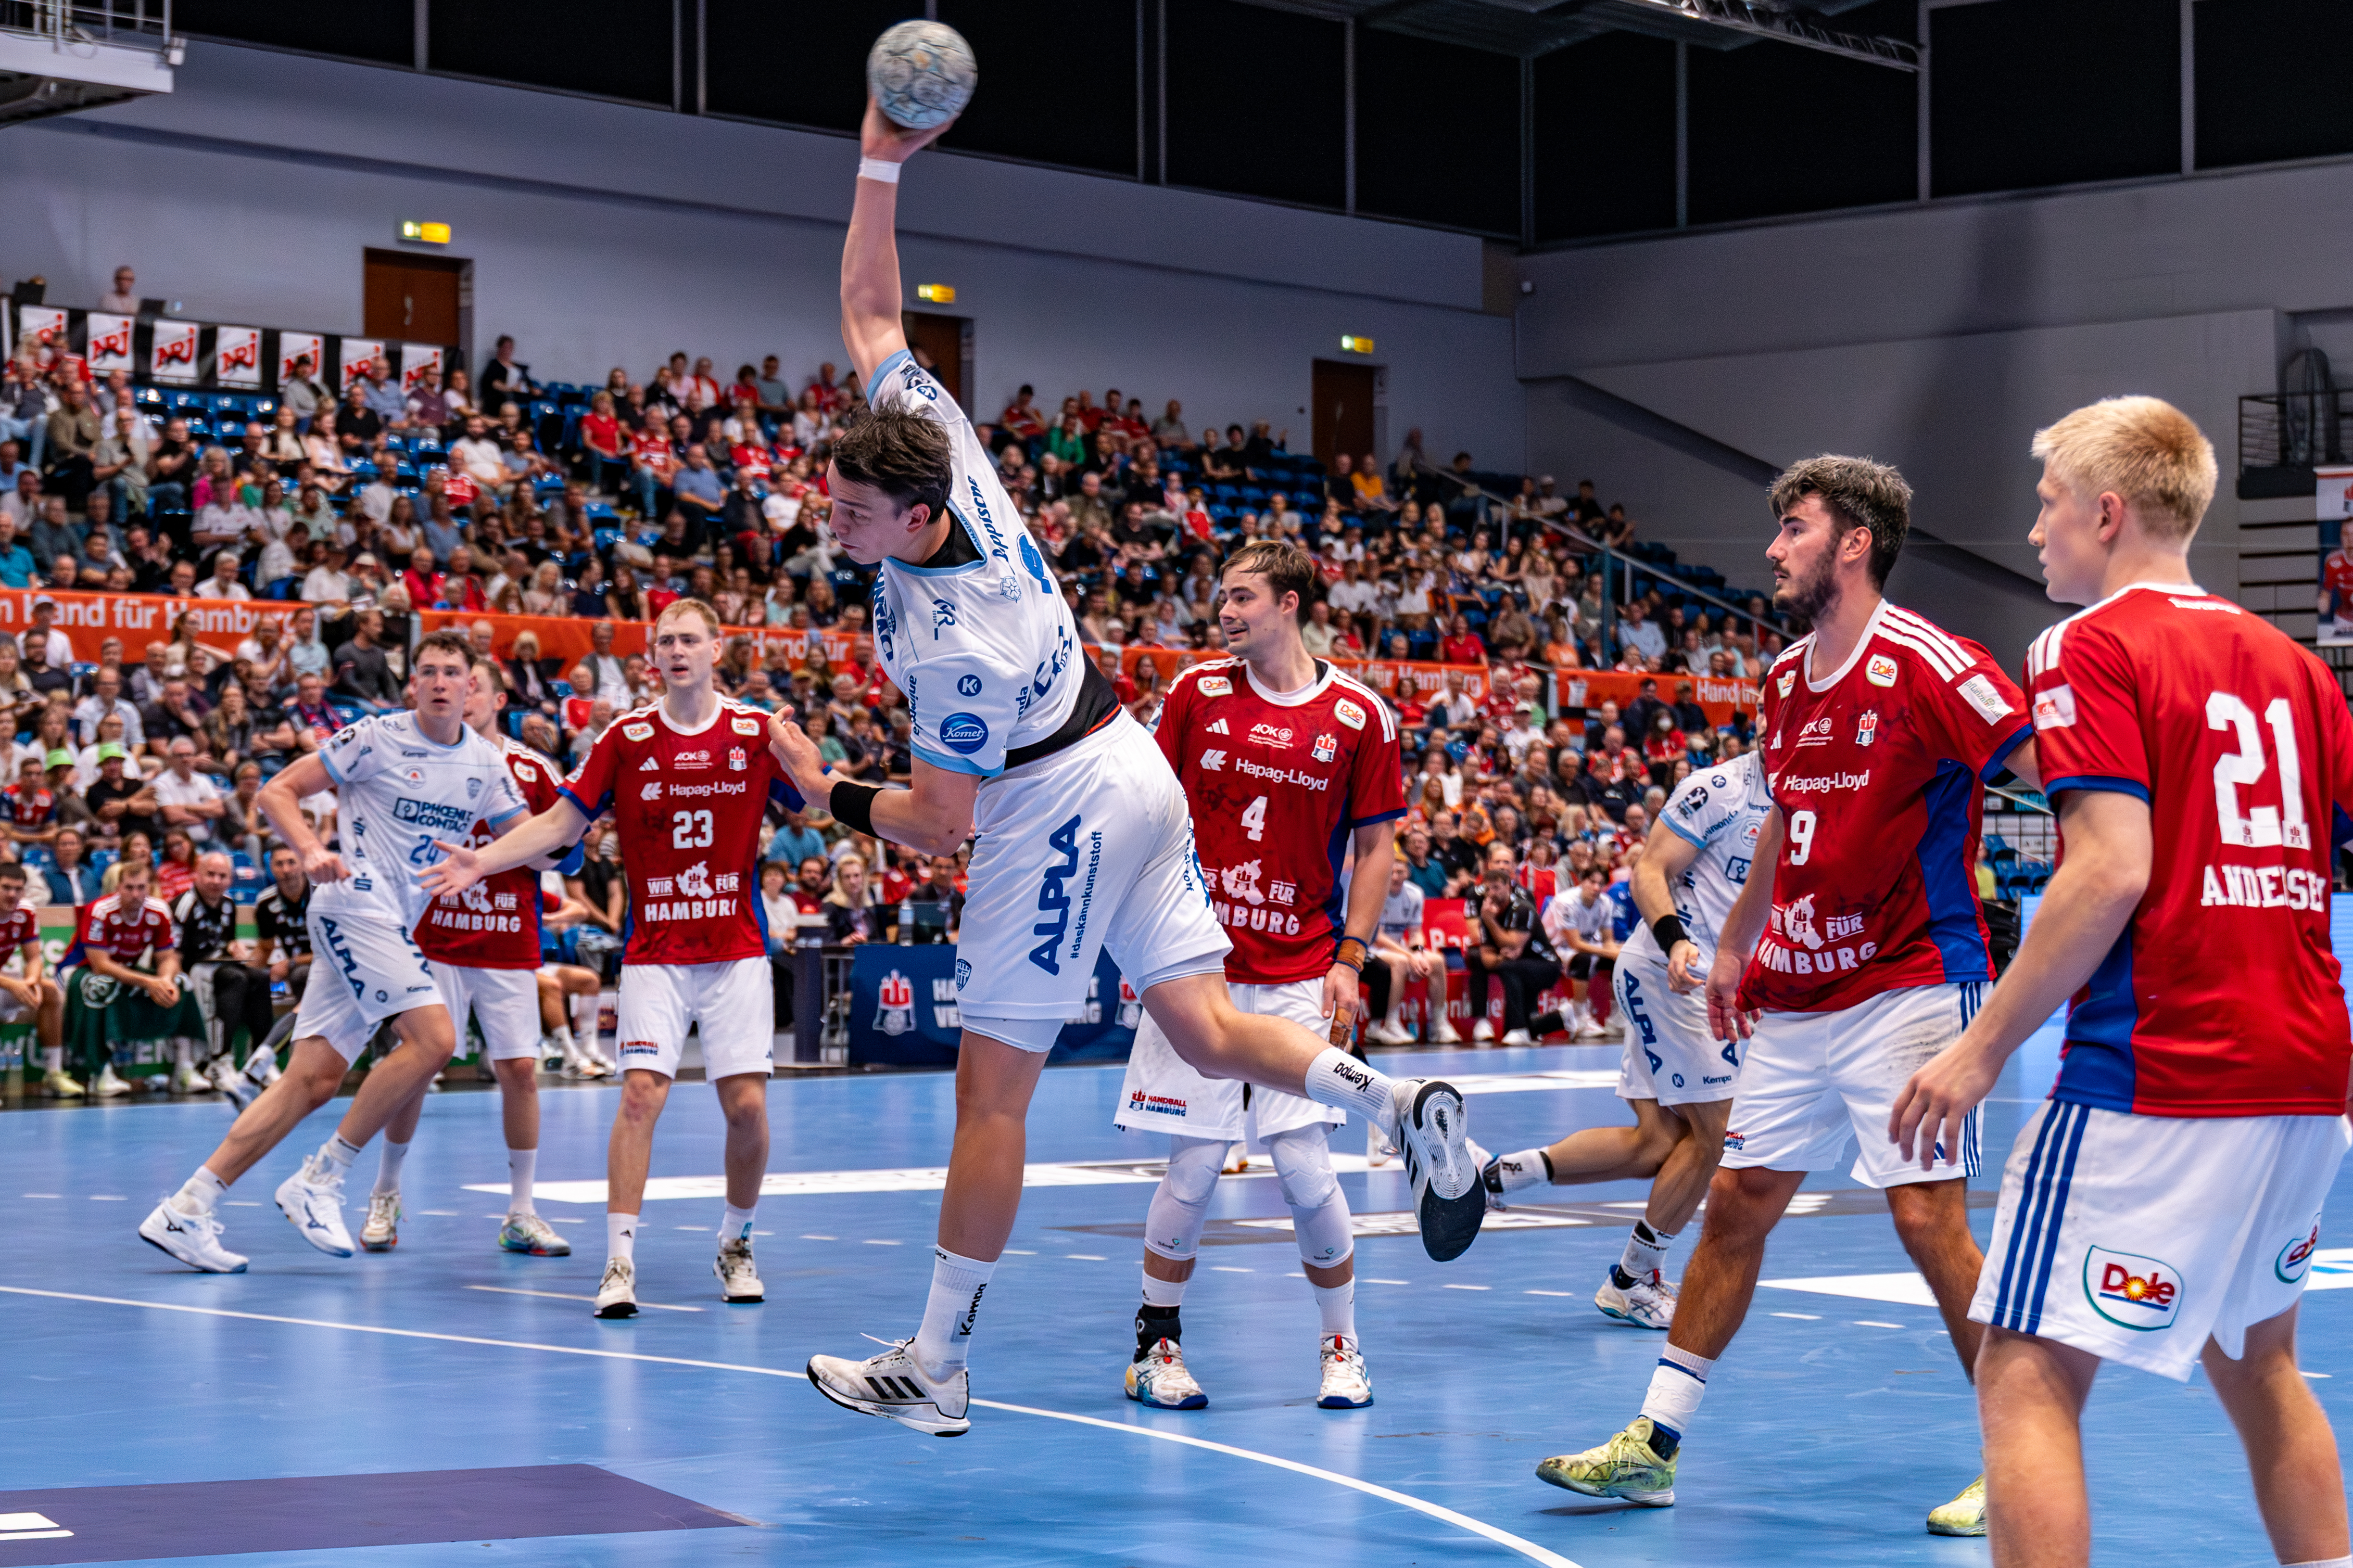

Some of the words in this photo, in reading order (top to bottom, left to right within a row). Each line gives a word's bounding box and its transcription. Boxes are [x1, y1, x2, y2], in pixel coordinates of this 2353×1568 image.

[112, 598, 157, 629] für
[166, 601, 300, 634] Hambg
[1398, 665, 1482, 699] Hamrg
[1871, 660, 1895, 677] Dole
[1204, 679, 1229, 691] Dole
[1696, 680, 1738, 704] Hand
[1339, 704, 1363, 722] Dole
[943, 724, 985, 741] Komet
[1250, 723, 1279, 737] AOK
[674, 752, 698, 761] AOK
[2205, 690, 2311, 851] 21
[669, 781, 745, 797] Hapag-Lloyd
[1235, 758, 1329, 792] Hapag-Lloyd
[1783, 769, 1869, 794] Hapag-Lloyd
[673, 809, 714, 849] 23
[1241, 796, 1268, 842] 4
[1790, 810, 1816, 866] 9
[647, 878, 673, 896] WIR
[1029, 814, 1081, 976] ALPLA
[1070, 831, 1103, 959] #daskannkunststoff
[2200, 864, 2326, 913] ANDESE
[431, 909, 521, 933] HAMBURG
[1215, 902, 1300, 935] MBURG
[1826, 914, 1864, 940] FÜR
[1759, 937, 1877, 975] HAMBURG
[1623, 967, 1663, 1076] ALPLA
[1334, 1062, 1375, 1093] Kempa
[1703, 1075, 1731, 1085] Kempa
[1145, 1104, 1186, 1117] HAMBURG
[1148, 1095, 1187, 1107] HANDBALL
[2100, 1262, 2176, 1305] Dole
[959, 1283, 988, 1336] Kempa
